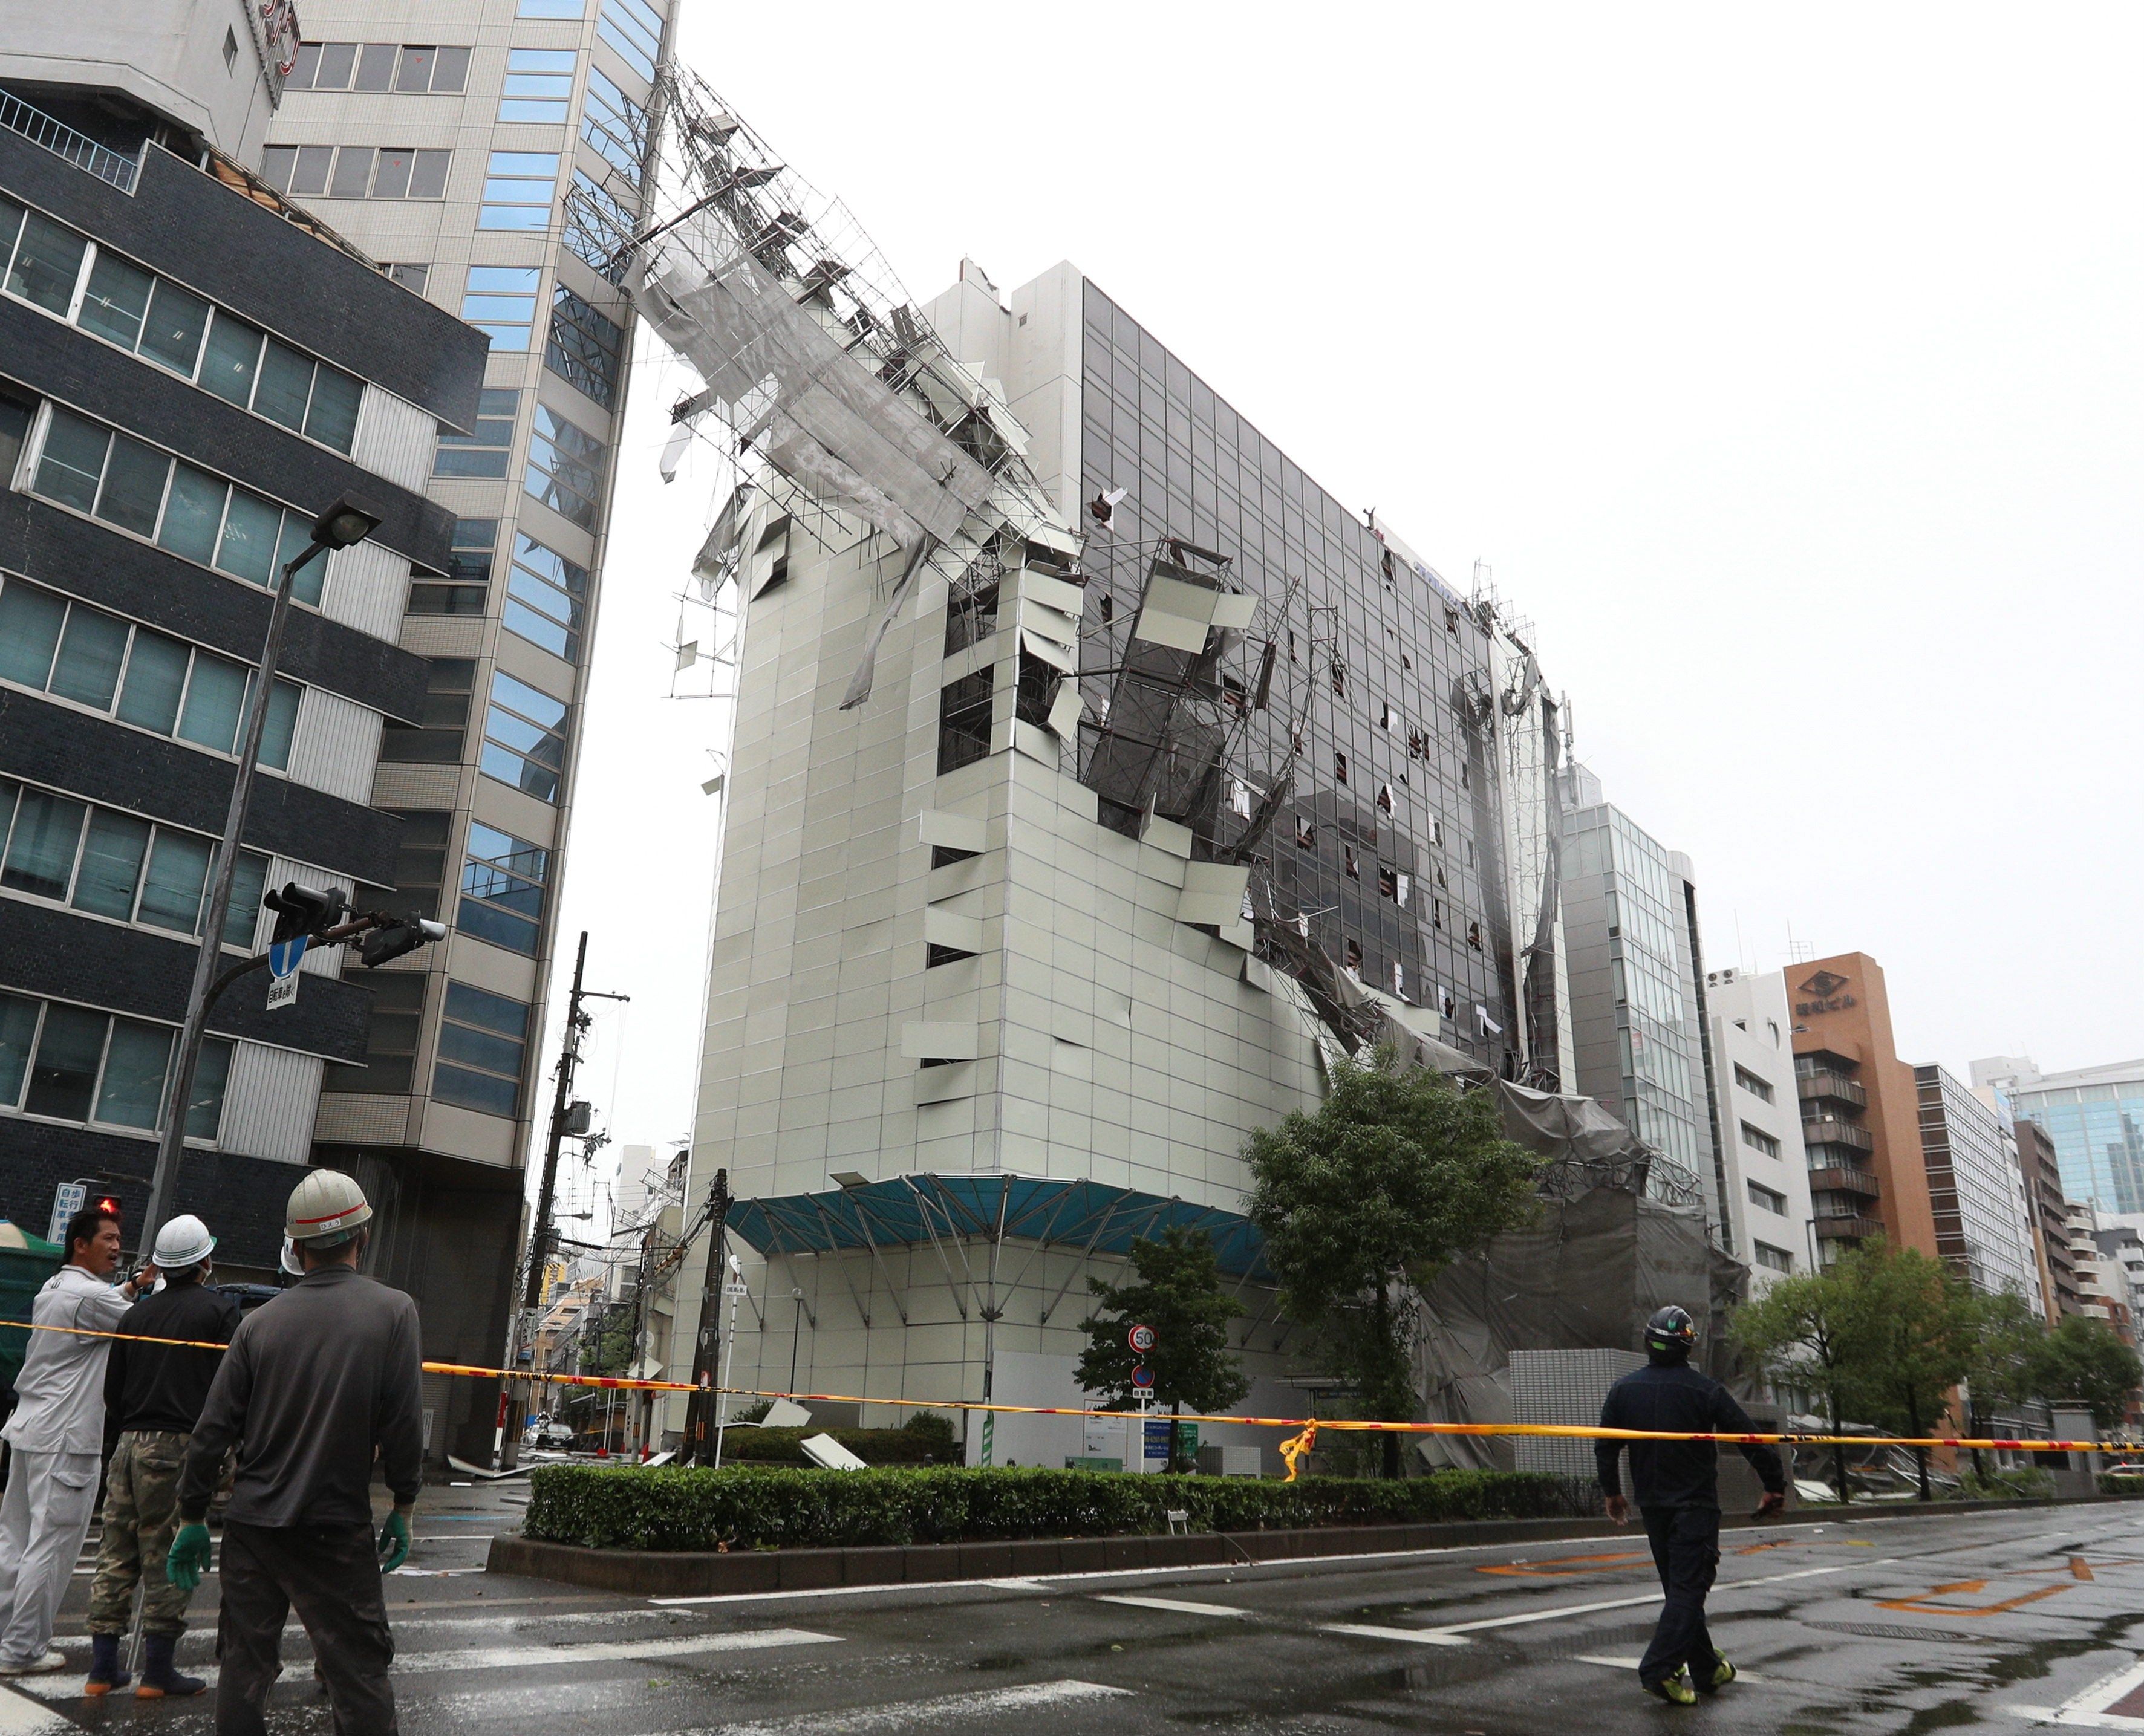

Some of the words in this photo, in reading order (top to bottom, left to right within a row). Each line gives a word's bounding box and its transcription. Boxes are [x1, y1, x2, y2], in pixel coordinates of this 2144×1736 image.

[269, 984, 295, 1003] 自転車を除く
[1136, 1332, 1152, 1345] 50
